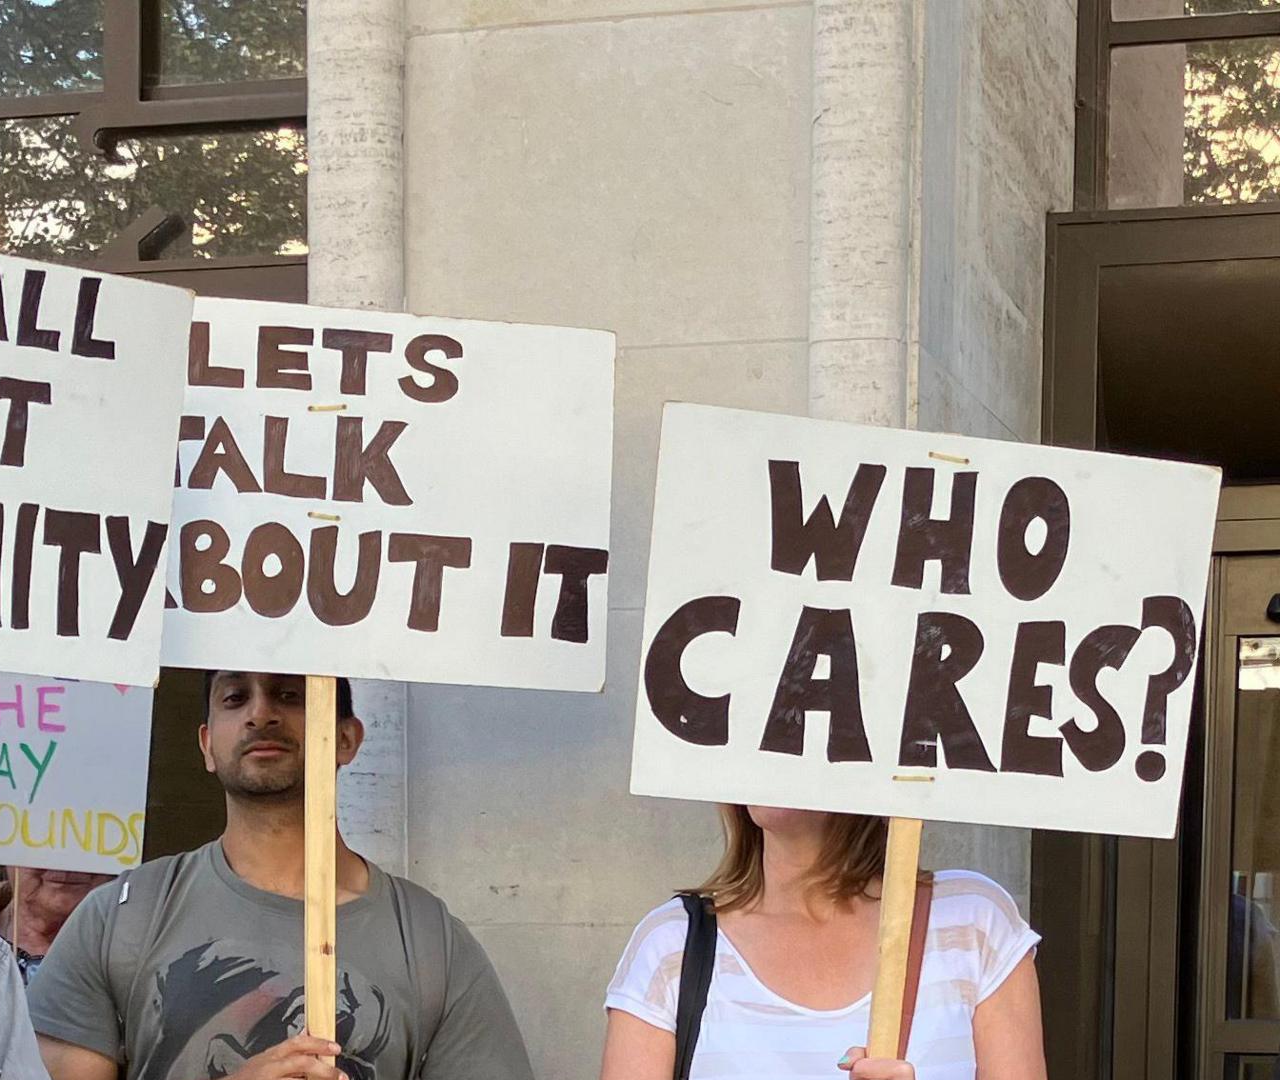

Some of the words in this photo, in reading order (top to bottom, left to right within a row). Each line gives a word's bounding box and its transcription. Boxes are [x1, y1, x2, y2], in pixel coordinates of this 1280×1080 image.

[188, 322, 463, 402] LETS
[164, 520, 472, 632] BOUT
[501, 542, 609, 643] IT
[769, 460, 1070, 601] WHO
[645, 596, 1196, 782] CARES?
